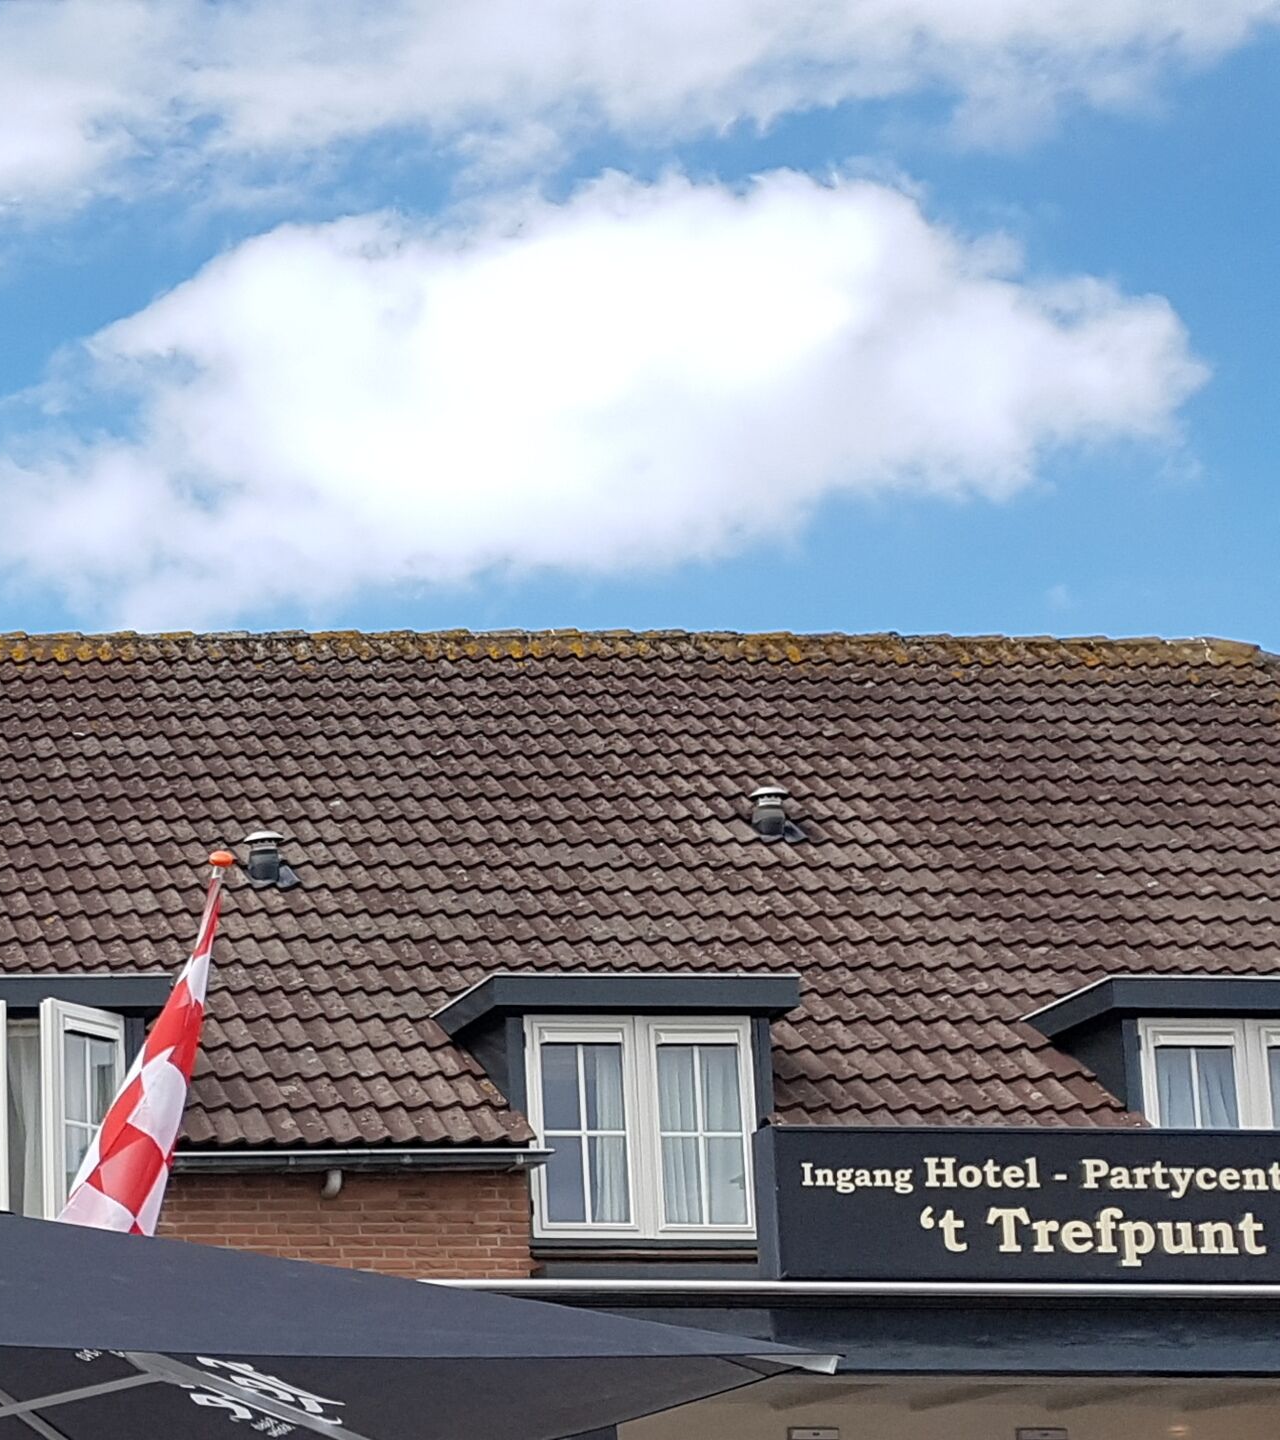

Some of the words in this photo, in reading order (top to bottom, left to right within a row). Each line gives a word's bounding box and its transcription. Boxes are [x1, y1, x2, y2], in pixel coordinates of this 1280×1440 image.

[801, 1162, 914, 1193] Ingang
[924, 1156, 1041, 1189] Hotel
[986, 1206, 1267, 1267] Trefpunt
